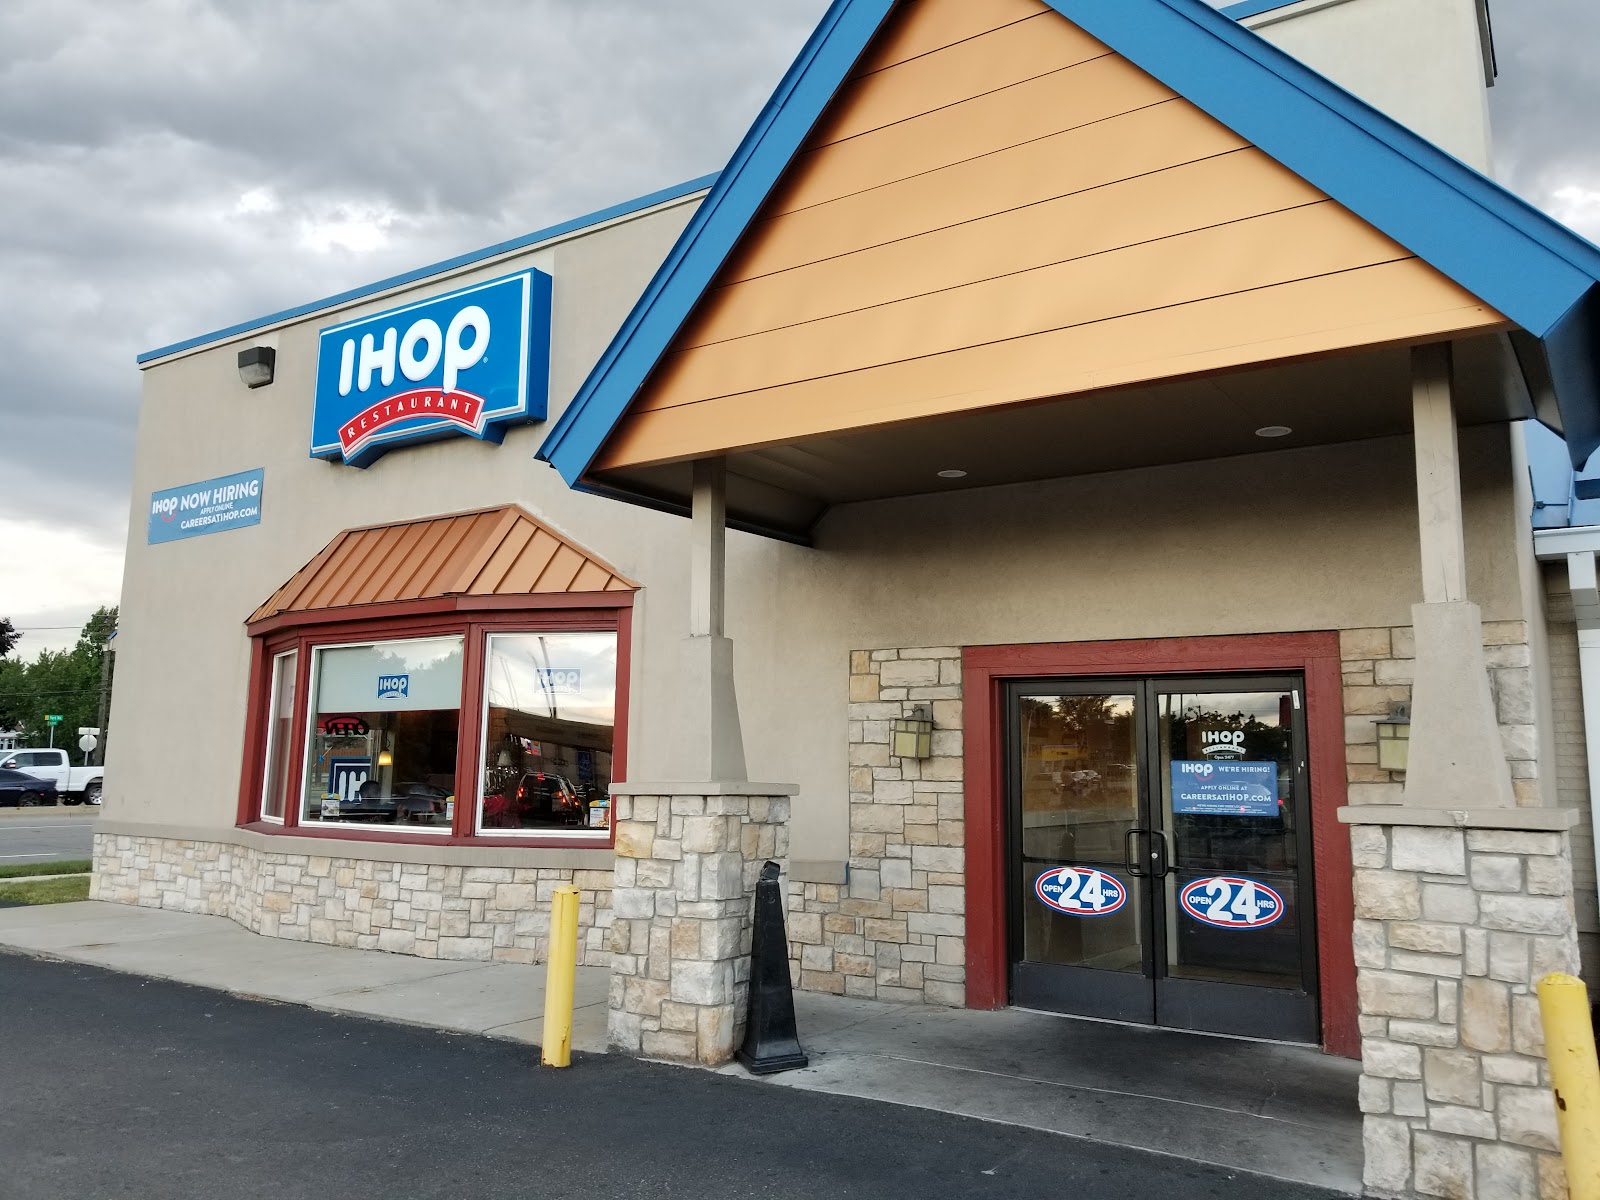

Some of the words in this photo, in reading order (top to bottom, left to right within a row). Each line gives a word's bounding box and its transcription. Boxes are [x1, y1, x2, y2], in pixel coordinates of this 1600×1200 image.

[338, 305, 491, 396] IHOP
[347, 396, 473, 439] RESTAURANT
[152, 496, 178, 516] IHOP
[180, 490, 211, 511] NOW
[212, 480, 259, 505] HIRING
[200, 505, 216, 515] APPLY
[215, 502, 234, 512] ONLINE
[180, 507, 258, 529] CAREERSATIHOP.COM
[380, 677, 407, 693] IHOP
[1201, 730, 1245, 746] IHOP
[1181, 763, 1213, 776] IHOP
[1181, 793, 1272, 802] CAREERSATIHOP.COM
[1043, 884, 1063, 894] OPEN
[1057, 868, 1105, 912] 24
[1102, 889, 1118, 898] HRS
[1189, 895, 1212, 905] OPEN
[1205, 879, 1260, 924] 24
[1257, 899, 1275, 909] HRS
